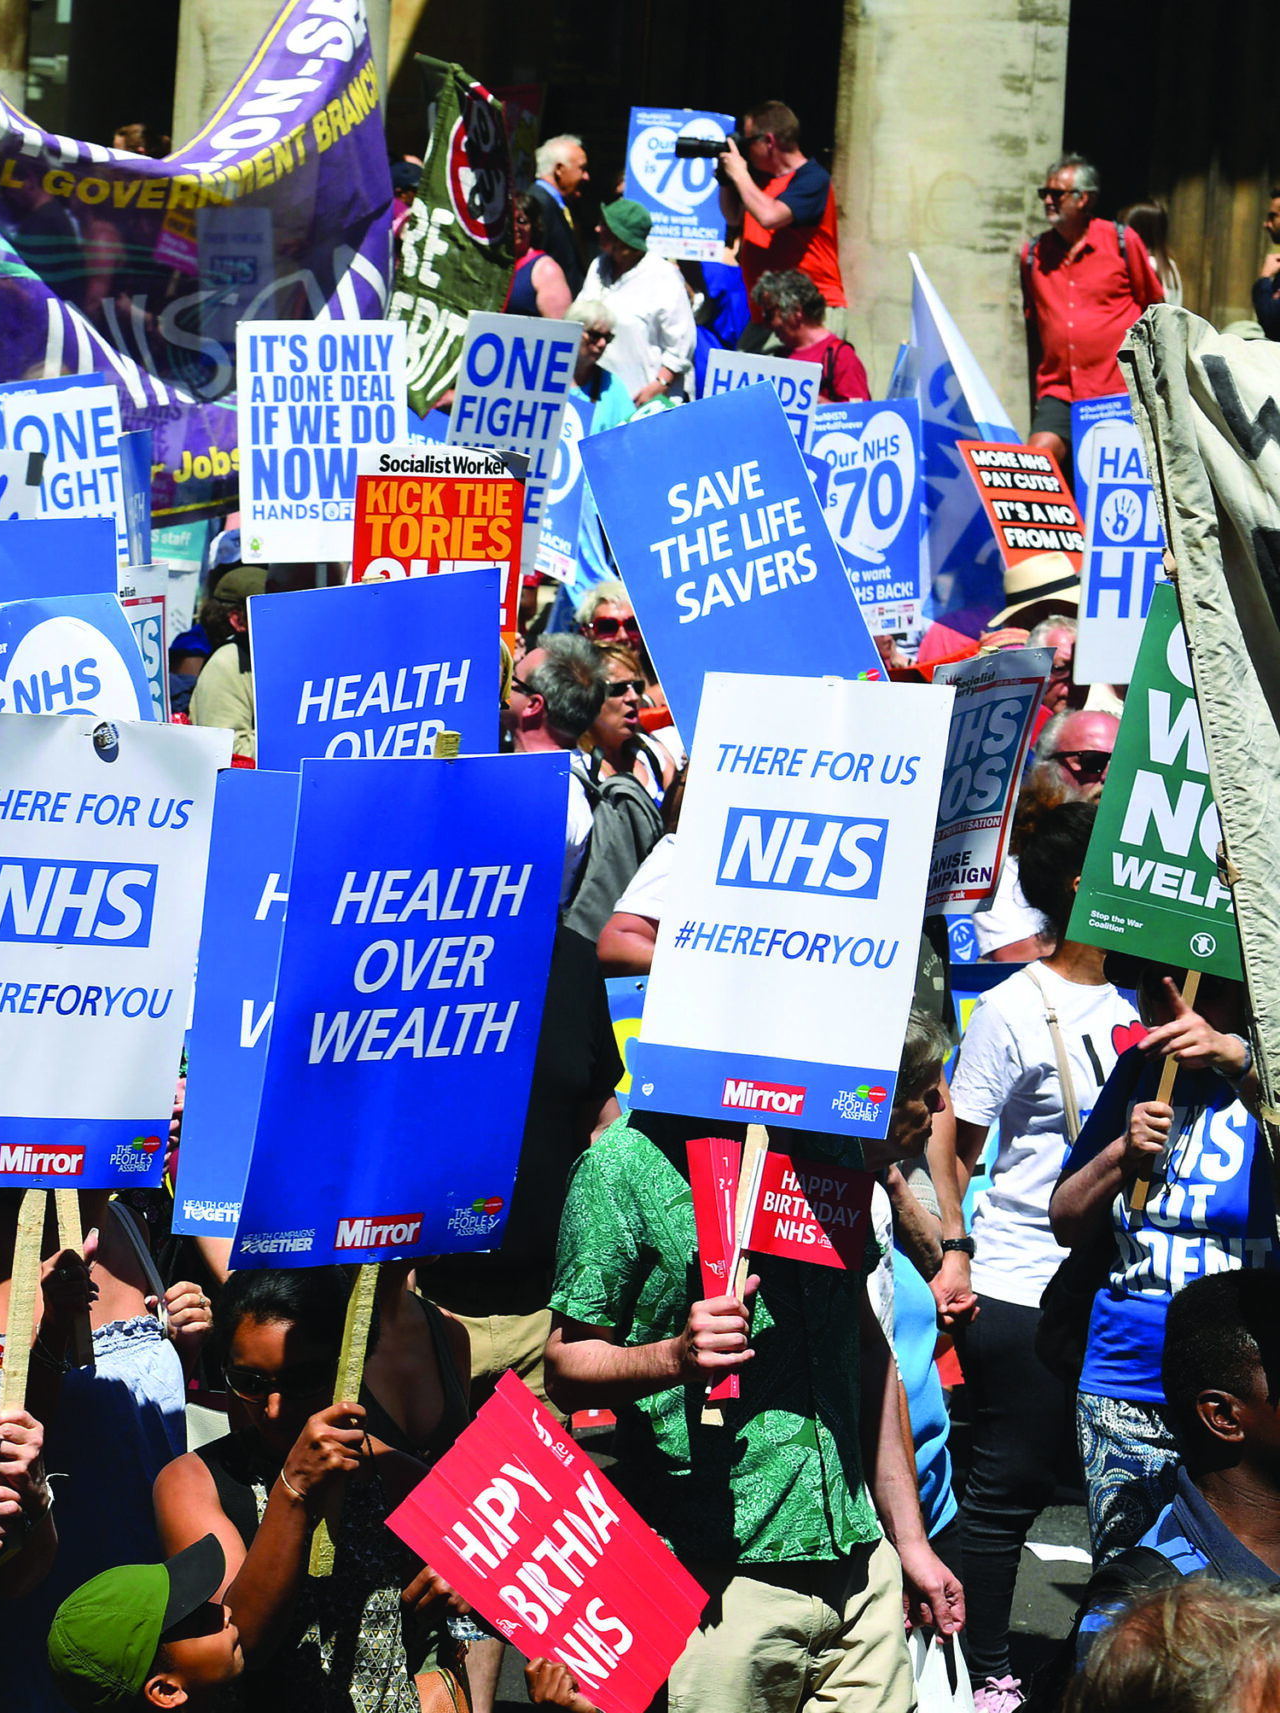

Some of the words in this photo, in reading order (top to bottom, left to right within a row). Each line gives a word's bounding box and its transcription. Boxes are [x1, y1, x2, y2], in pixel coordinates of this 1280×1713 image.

[312, 58, 380, 153] BRANCH
[250, 335, 308, 372] IT'S
[320, 334, 395, 373] ONLY
[466, 333, 573, 394] ONE
[251, 377, 264, 403] A
[273, 376, 333, 403] DONE
[341, 375, 395, 402] DEAL
[13, 406, 117, 463] ONE
[251, 405, 278, 446] IF
[288, 405, 340, 445] WE
[351, 404, 396, 444] DO
[455, 396, 561, 441] FIGHT
[379, 452, 453, 475] Socialist
[453, 454, 508, 475] Worker
[824, 449, 858, 470] Our
[863, 434, 900, 464] NHS
[970, 450, 1020, 468] MORE
[1018, 453, 1052, 472] NHS
[40, 466, 118, 512] IGHT
[365, 481, 447, 515] KICK
[455, 483, 513, 516] THE
[668, 460, 765, 525] SAVE
[833, 459, 903, 539] 70
[979, 471, 1013, 487] PAY
[1013, 472, 1060, 492] CUTS?
[252, 505, 320, 521] HANDS
[992, 500, 1031, 521] IT'S
[1031, 503, 1048, 523] A
[1044, 504, 1076, 526] NO
[365, 516, 512, 560] TORIES
[650, 520, 733, 579] THE
[740, 497, 806, 551] LIFE
[1003, 527, 1061, 550] FROM
[675, 543, 818, 624] SAVERS
[862, 566, 892, 583] want
[875, 582, 914, 602] BACK!
[13, 657, 102, 715] NHS
[297, 659, 471, 724] HEALTH
[957, 672, 996, 690] Socialist
[717, 743, 807, 778] THERE
[811, 750, 875, 786] FOR
[880, 755, 921, 786] US
[76, 793, 141, 827] FOR
[147, 797, 194, 829] US
[720, 813, 884, 893] NHS
[331, 864, 533, 925] HEALTH
[1088, 918, 1125, 933] Coalition
[1090, 910, 1110, 922] Stop
[1111, 915, 1125, 924] the
[1127, 918, 1144, 929] War
[675, 920, 899, 970] #HEREFORYOU
[353, 935, 495, 994] OVER
[308, 1001, 520, 1065] WEALTH
[723, 1080, 804, 1113] Mirror
[838, 1090, 857, 1102] THE
[840, 1110, 879, 1122] ASSEMBLY
[0, 1145, 83, 1174] Mirror
[116, 1144, 132, 1154] THE
[117, 1162, 152, 1173] ASSEMBLY
[780, 1169, 848, 1200] HAPPY
[455, 1208, 472, 1218] THE
[762, 1191, 861, 1228] BIRTHDAY
[334, 1221, 421, 1249] Mirror
[456, 1226, 492, 1237] ASSEMBLY
[774, 1218, 817, 1245] NHS
